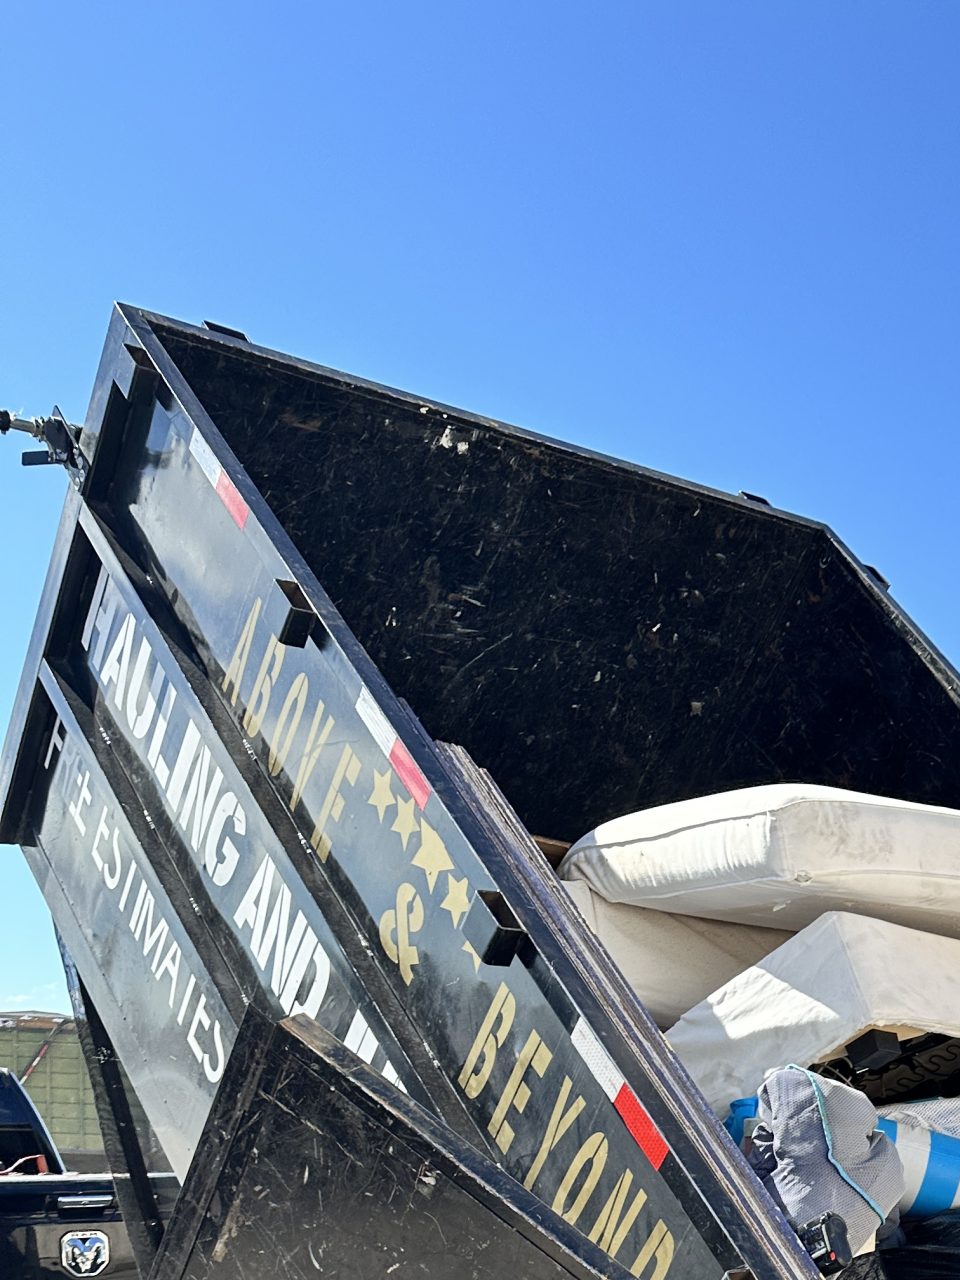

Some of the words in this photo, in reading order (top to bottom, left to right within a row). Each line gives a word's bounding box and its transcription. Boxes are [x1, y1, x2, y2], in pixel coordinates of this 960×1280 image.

[81, 564, 247, 886] HAULING
[233, 856, 332, 1021] AND
[90, 804, 226, 1084] ESTIMATES
[221, 597, 362, 862] ABOVE
[379, 881, 426, 986] &
